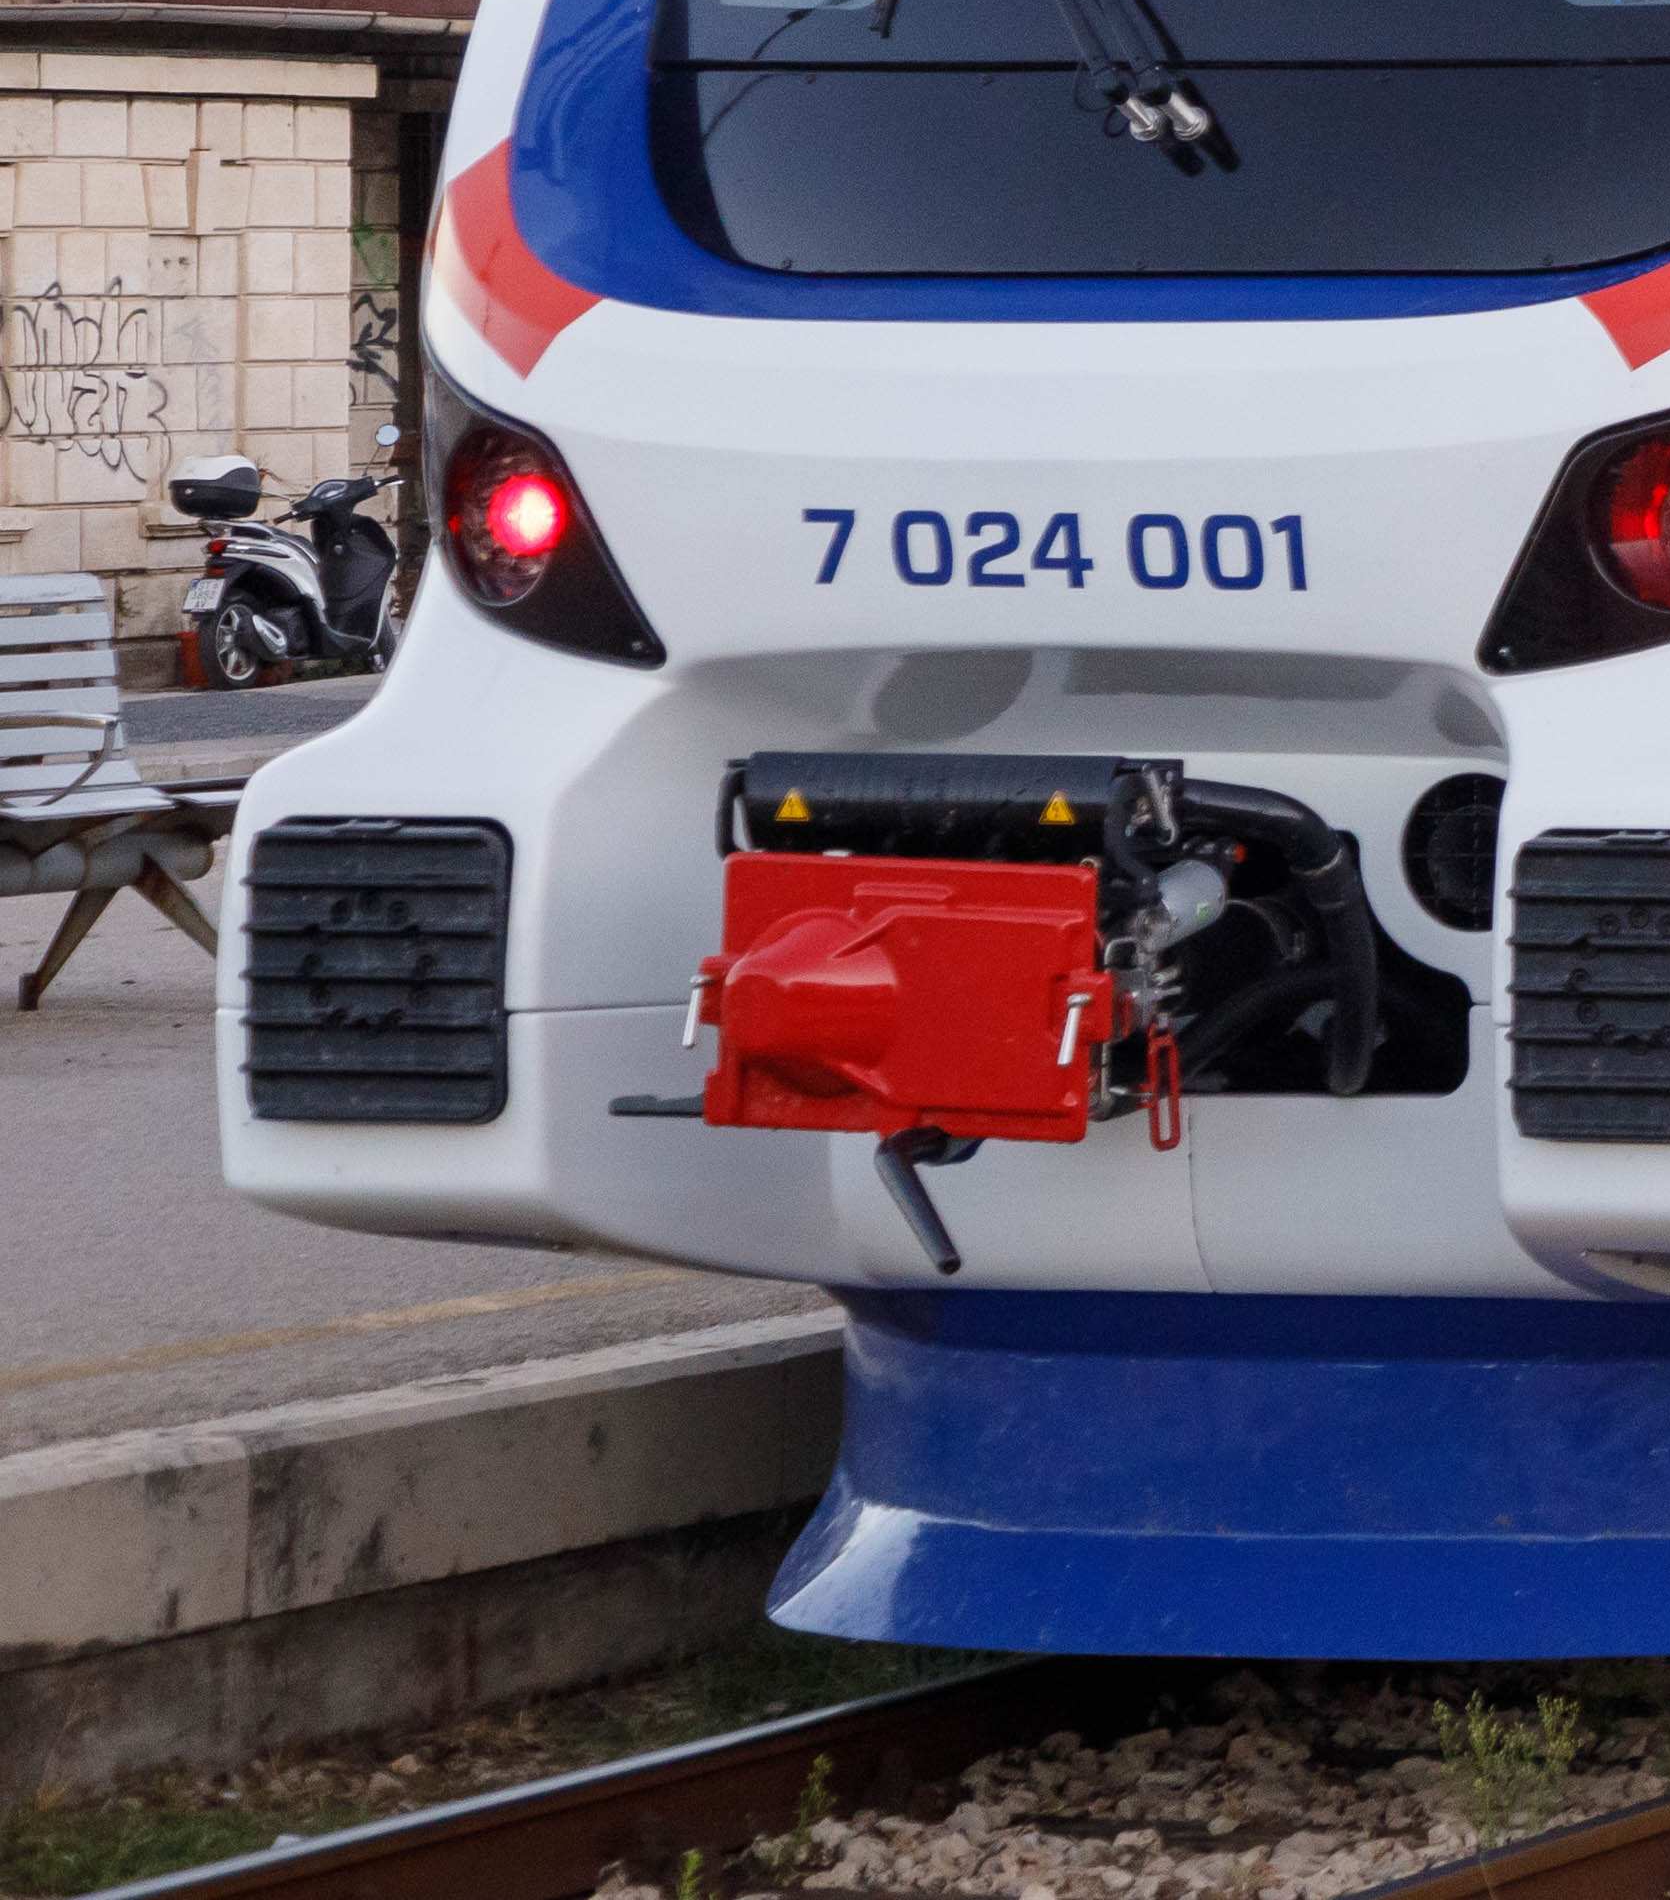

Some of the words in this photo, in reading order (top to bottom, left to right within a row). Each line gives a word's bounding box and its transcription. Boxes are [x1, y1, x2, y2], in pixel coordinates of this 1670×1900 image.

[801, 508, 855, 584] 7
[891, 510, 1094, 589] 024
[1126, 512, 1308, 592] 001
